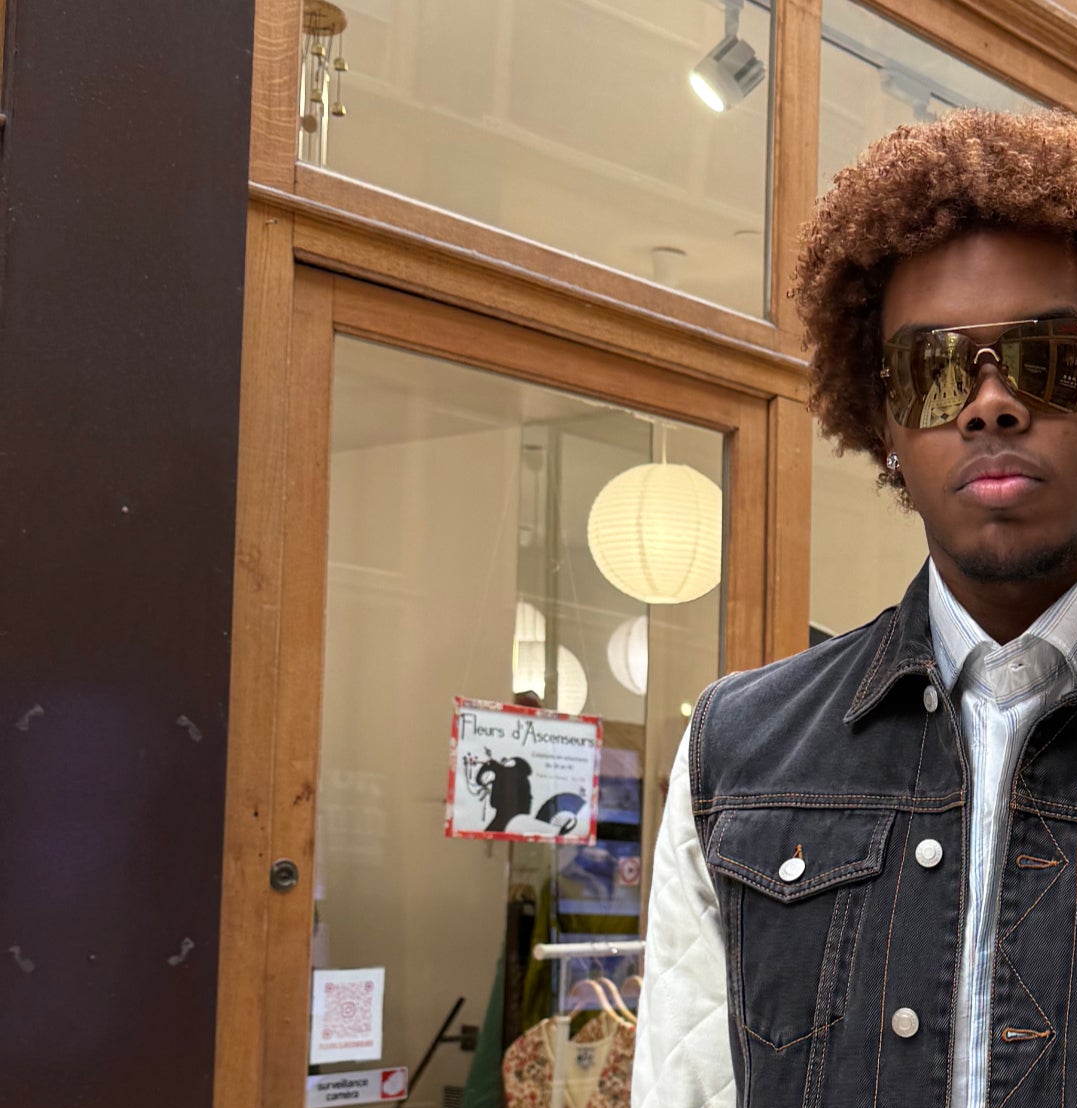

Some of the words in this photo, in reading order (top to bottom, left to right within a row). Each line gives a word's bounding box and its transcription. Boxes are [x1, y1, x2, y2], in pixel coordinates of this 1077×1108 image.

[460, 713, 505, 740] Fleurs
[512, 719, 595, 747] d'Ascenseurs
[317, 1078, 369, 1091] surveillance
